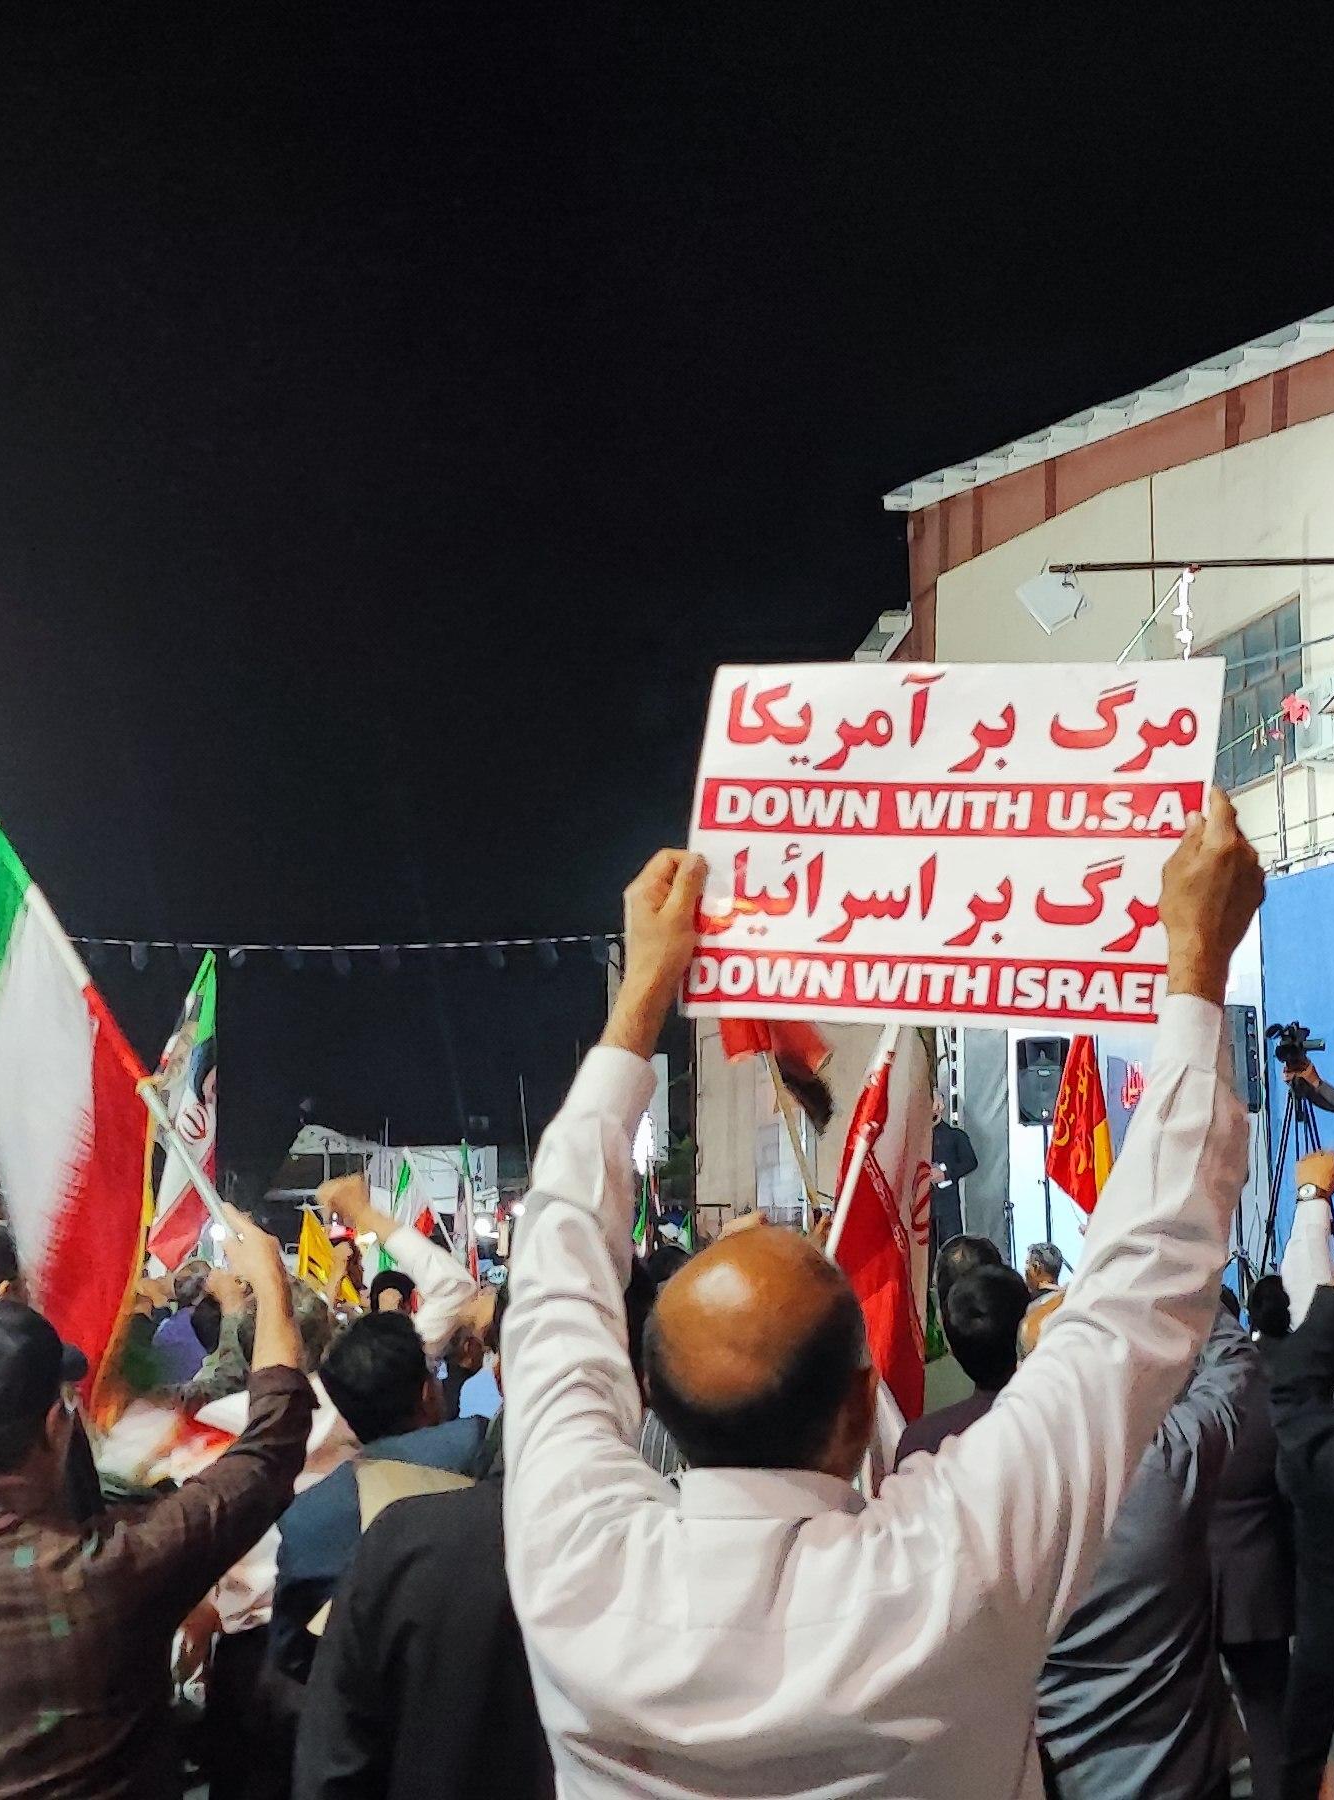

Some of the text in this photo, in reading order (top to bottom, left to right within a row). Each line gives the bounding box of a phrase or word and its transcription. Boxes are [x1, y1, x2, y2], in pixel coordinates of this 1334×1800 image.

[727, 672, 1198, 773] مرگ بر آمریکا
[714, 784, 879, 830] DOWN
[895, 789, 1034, 831] WITH
[694, 842, 937, 943] اسرائیل
[943, 876, 1013, 946] بر
[689, 955, 847, 1000] DOWN
[853, 961, 992, 1005] WITH
